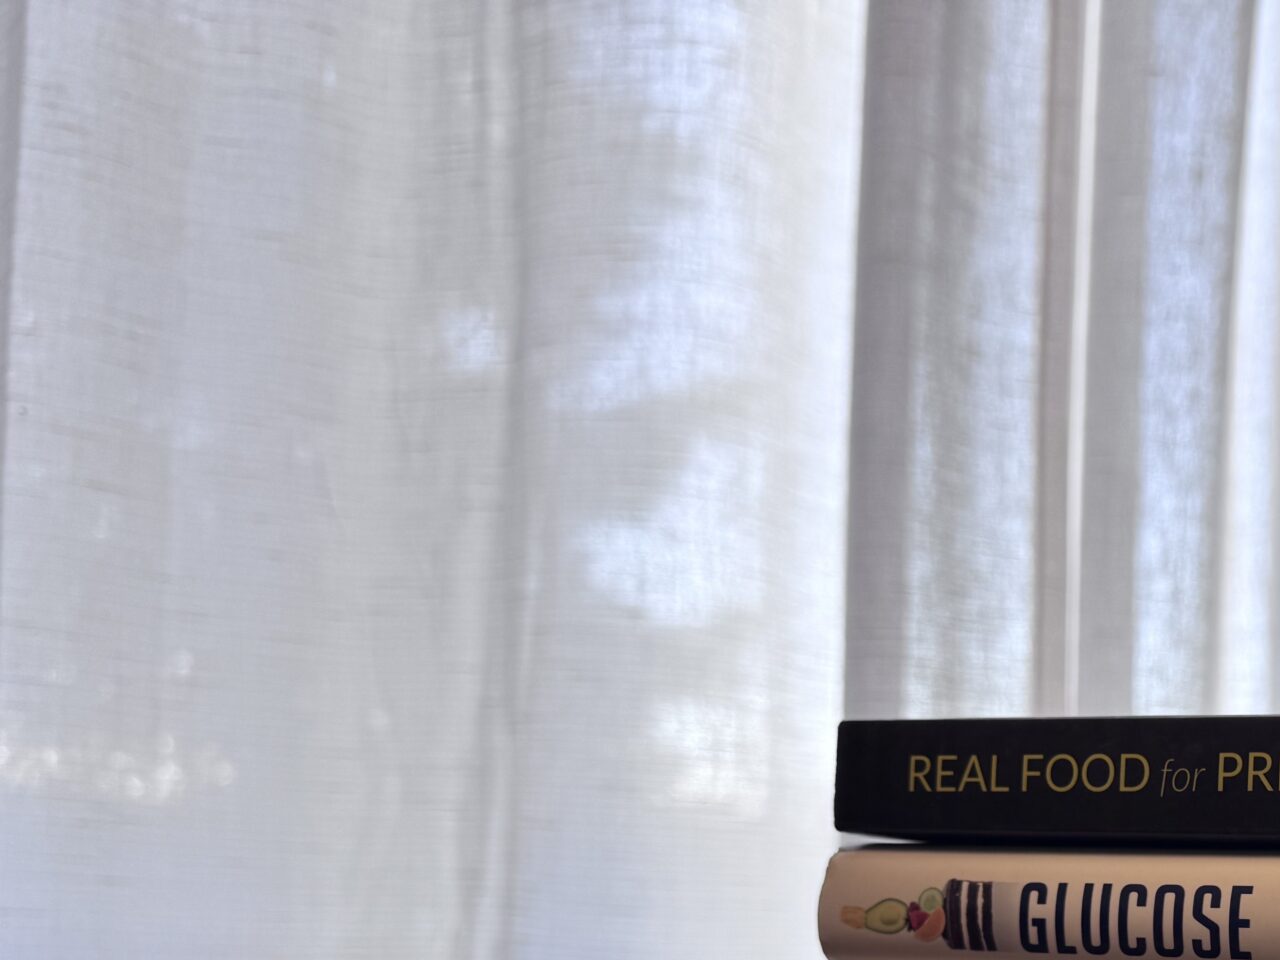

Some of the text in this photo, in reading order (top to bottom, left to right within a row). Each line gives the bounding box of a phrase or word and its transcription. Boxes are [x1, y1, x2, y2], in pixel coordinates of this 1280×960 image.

[907, 755, 1009, 793] REAL
[1021, 753, 1151, 794] FOOD
[1159, 758, 1207, 798] for
[1018, 881, 1255, 960] GLUCOSE
